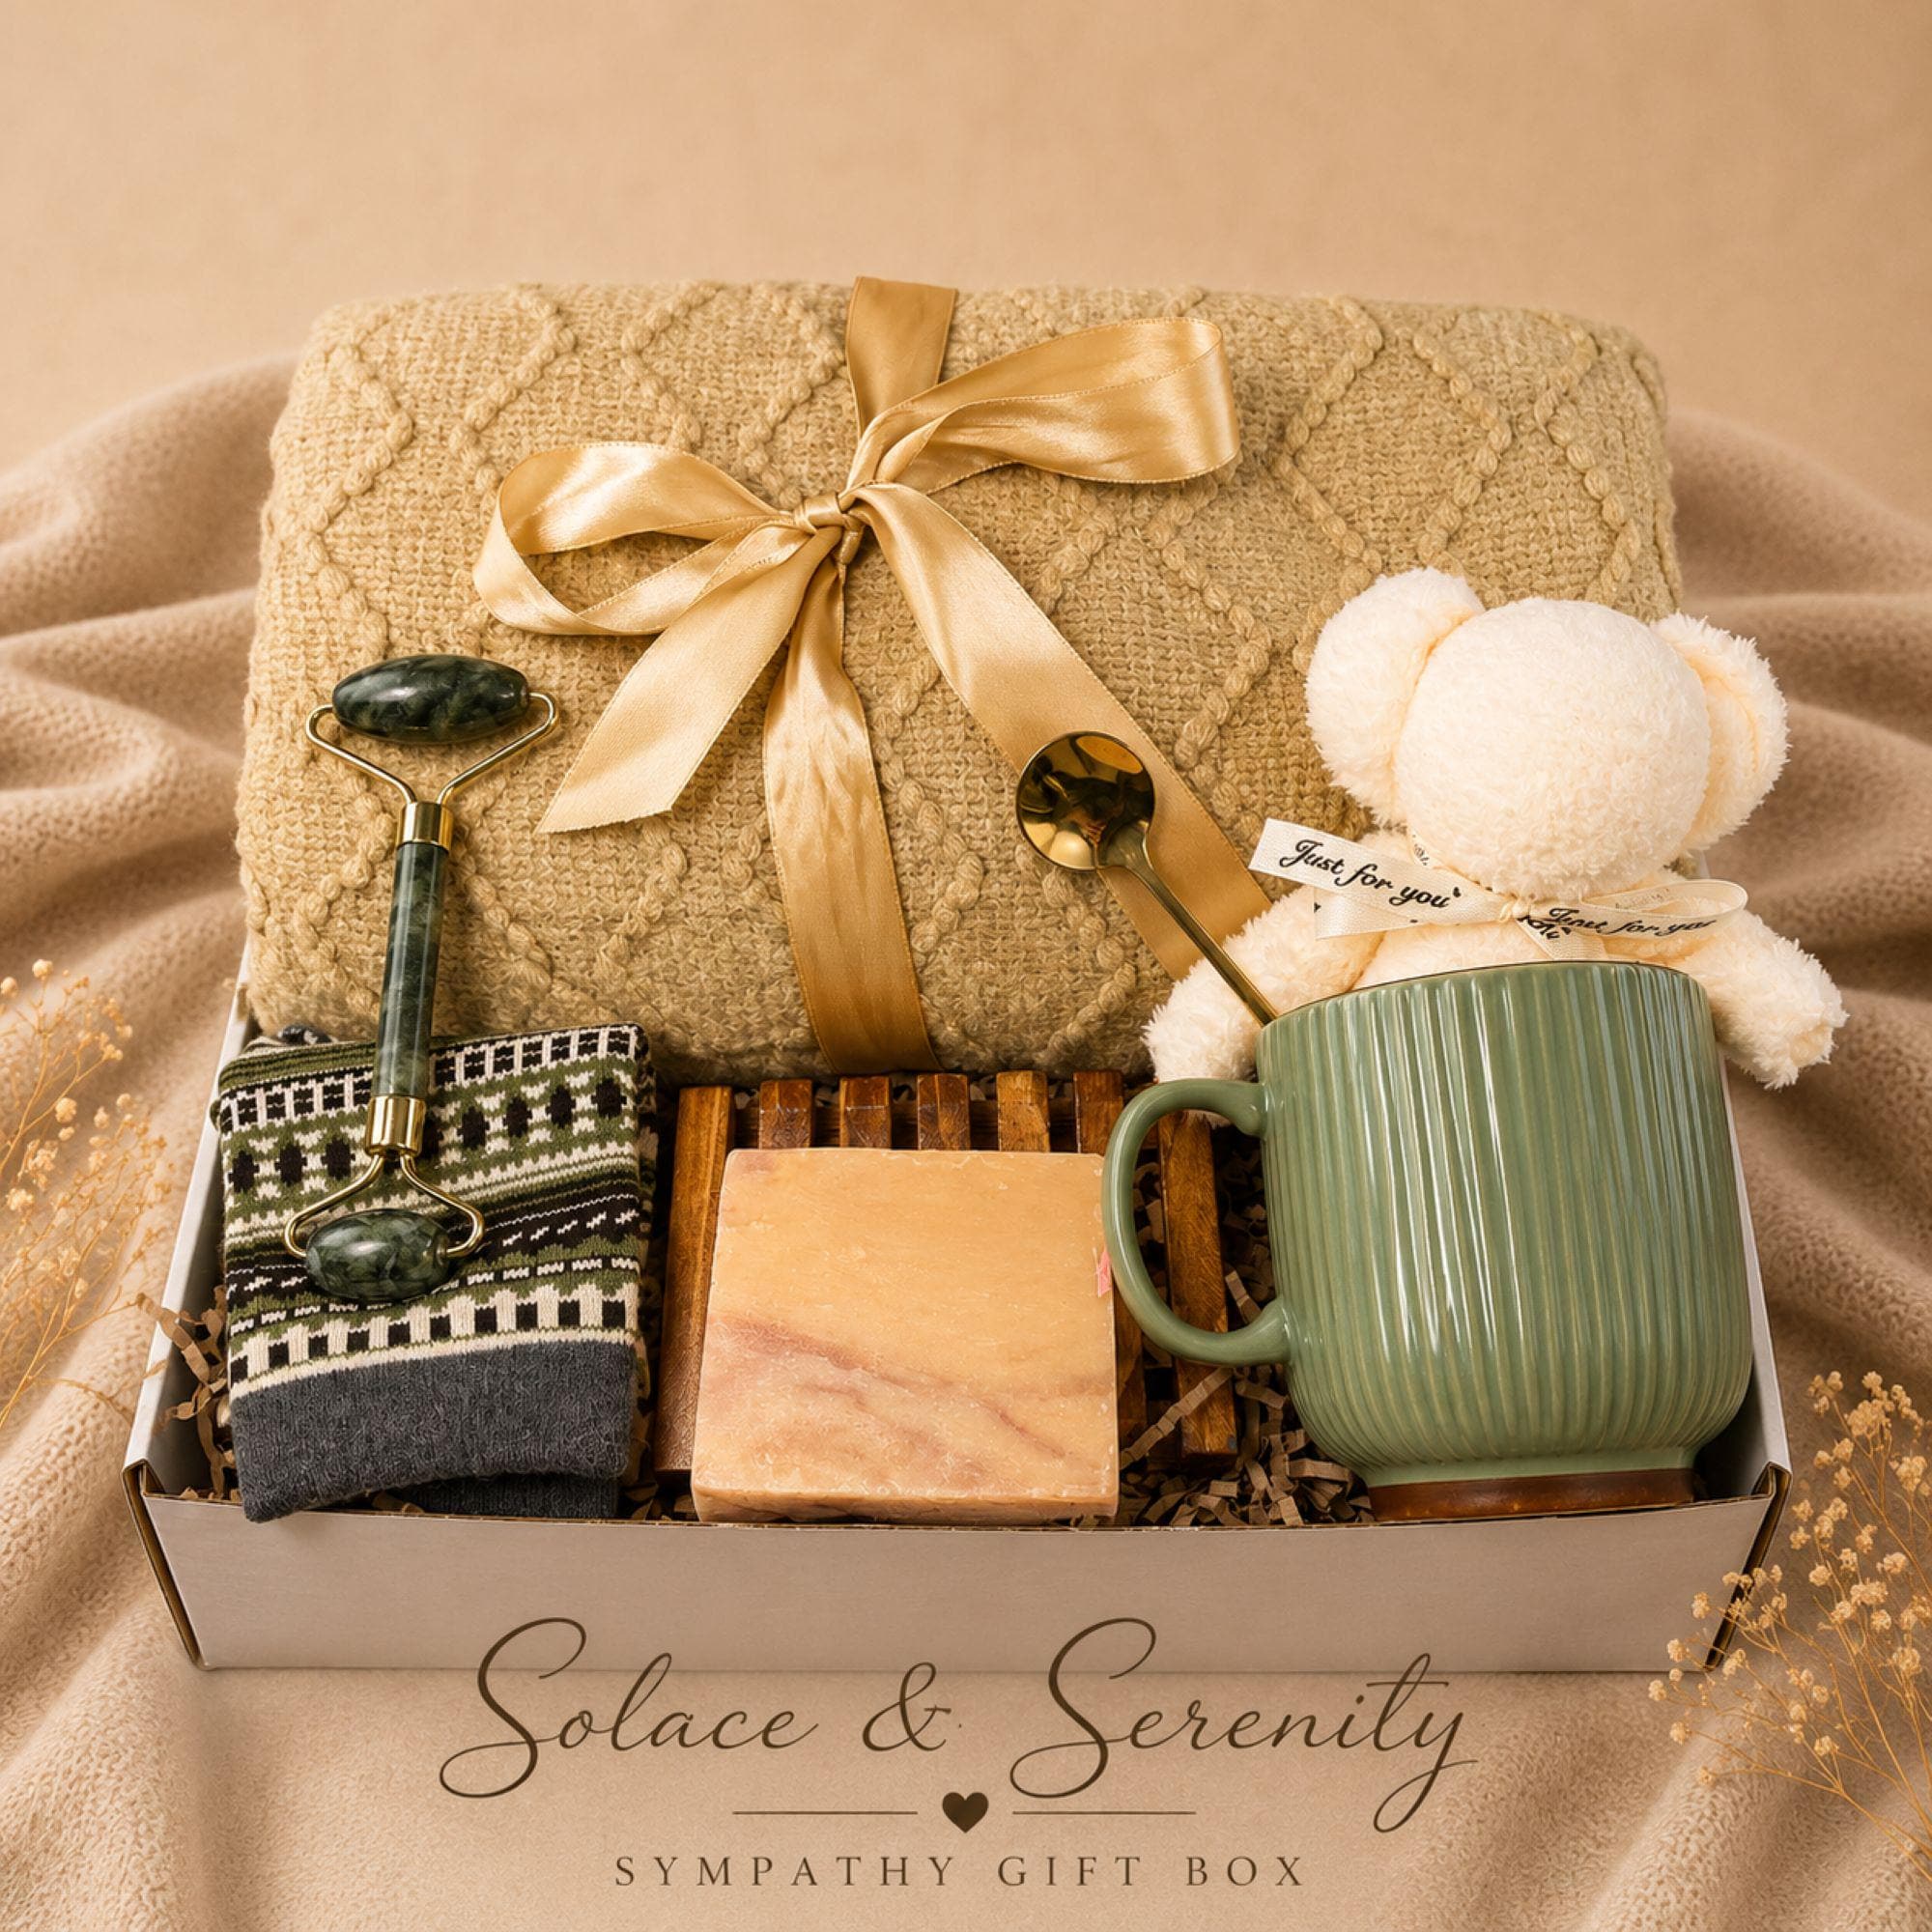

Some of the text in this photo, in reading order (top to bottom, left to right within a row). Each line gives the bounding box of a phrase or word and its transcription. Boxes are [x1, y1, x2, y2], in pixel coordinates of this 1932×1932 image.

[1279, 838, 1450, 909] Just for you
